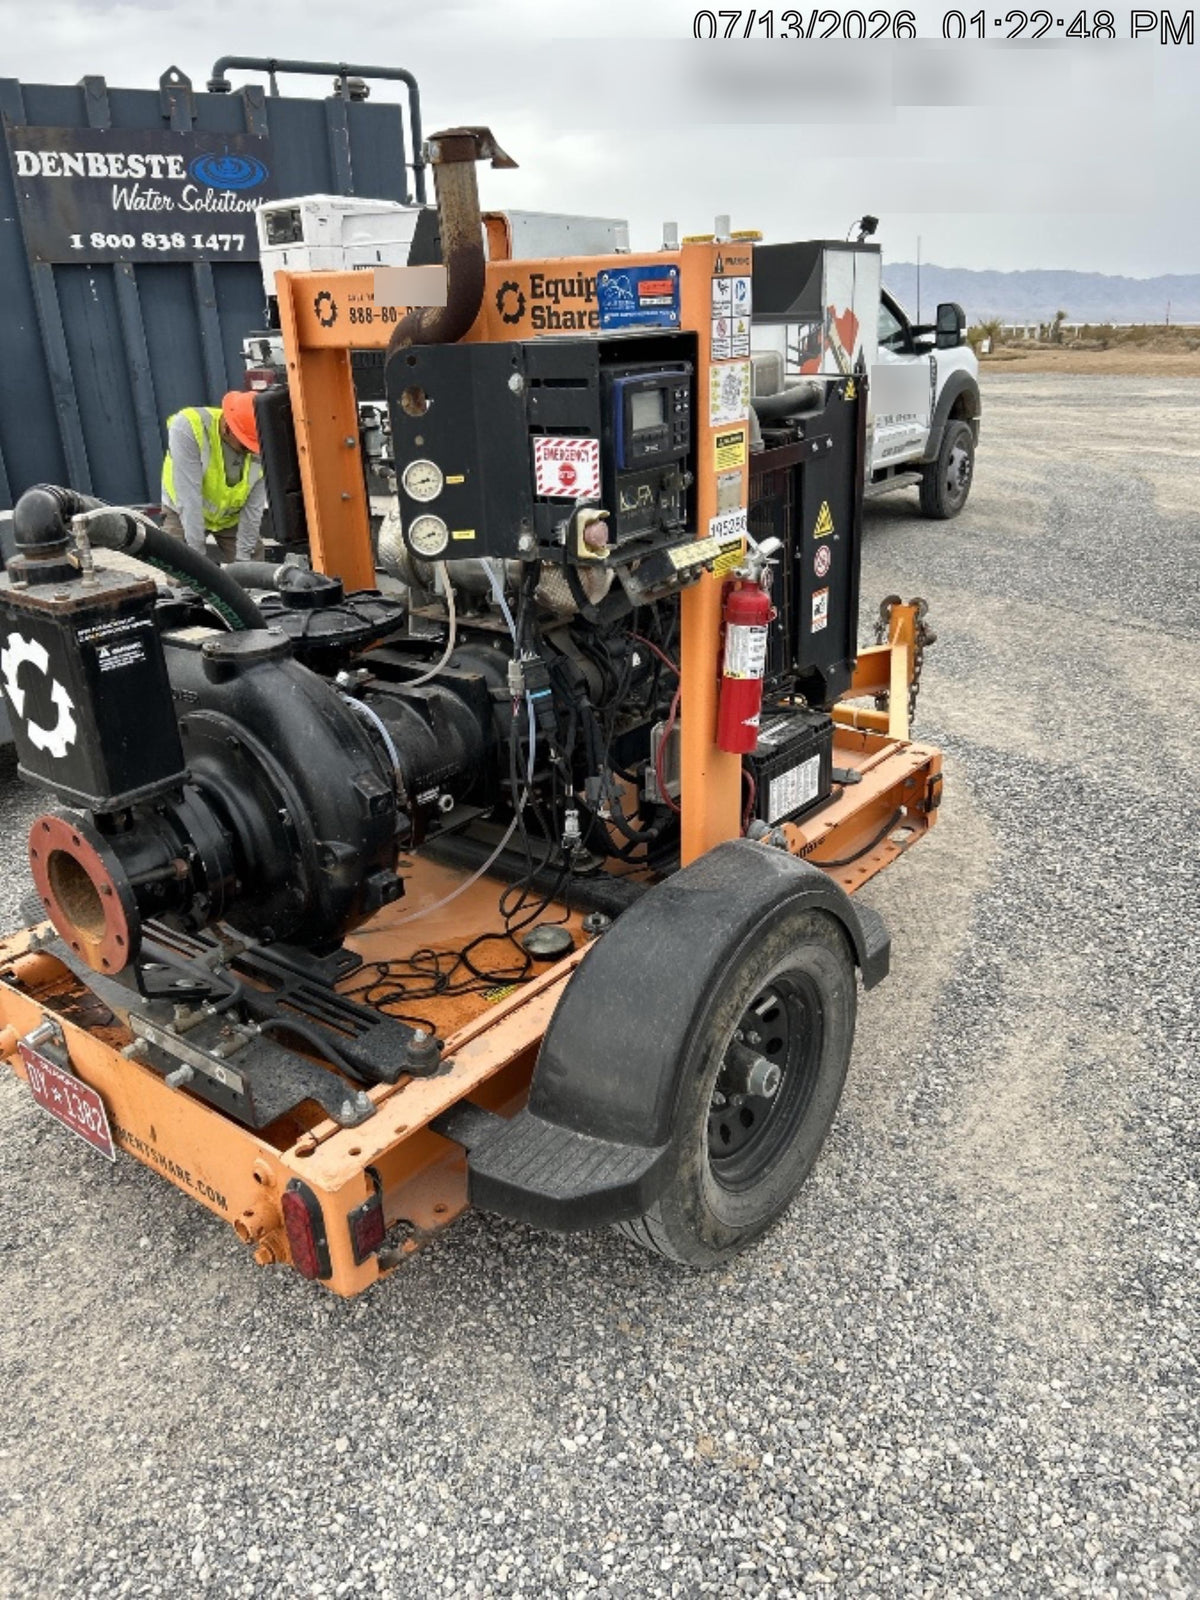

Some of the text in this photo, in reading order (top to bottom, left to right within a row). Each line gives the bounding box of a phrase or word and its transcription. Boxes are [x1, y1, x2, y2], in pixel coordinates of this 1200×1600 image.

[14, 150, 187, 179] DENBESTE
[111, 183, 176, 213] Water
[70, 232, 246, 252] 1 800 838 1477
[530, 305, 599, 330] Share
[543, 447, 589, 463] EMERGENCY
[559, 470, 575, 480] STOP
[63, 1086, 107, 1141] 1382
[117, 1126, 229, 1212] MENTSHARE.COM
